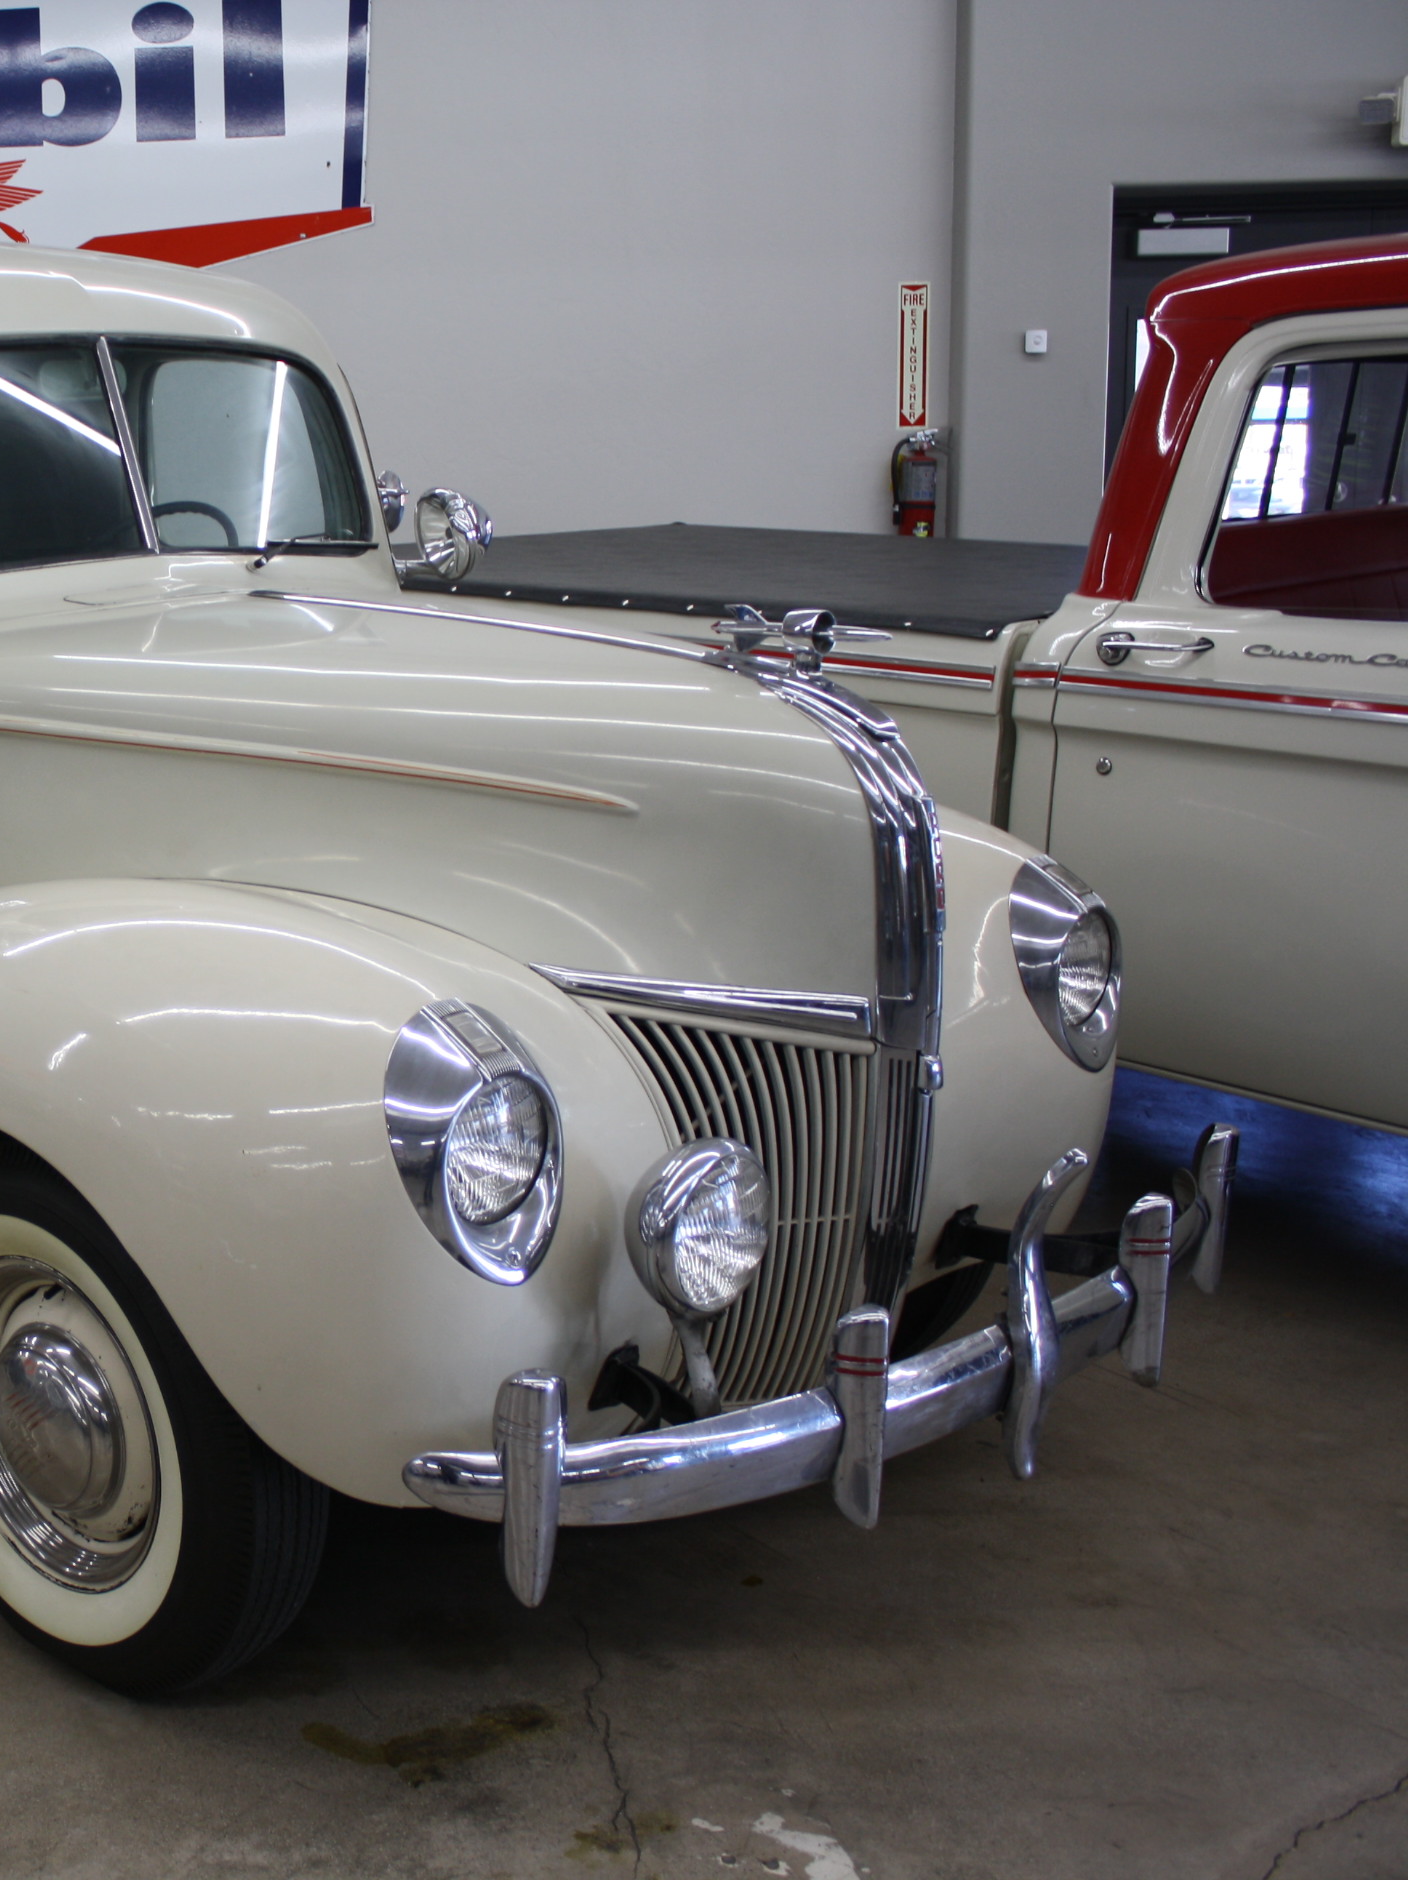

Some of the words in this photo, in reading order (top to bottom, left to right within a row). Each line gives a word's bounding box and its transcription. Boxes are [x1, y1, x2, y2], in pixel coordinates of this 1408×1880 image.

[903, 293, 925, 307] FIRE
[909, 308, 918, 420] EXTINGUISHER
[1242, 644, 1359, 665] Custom
